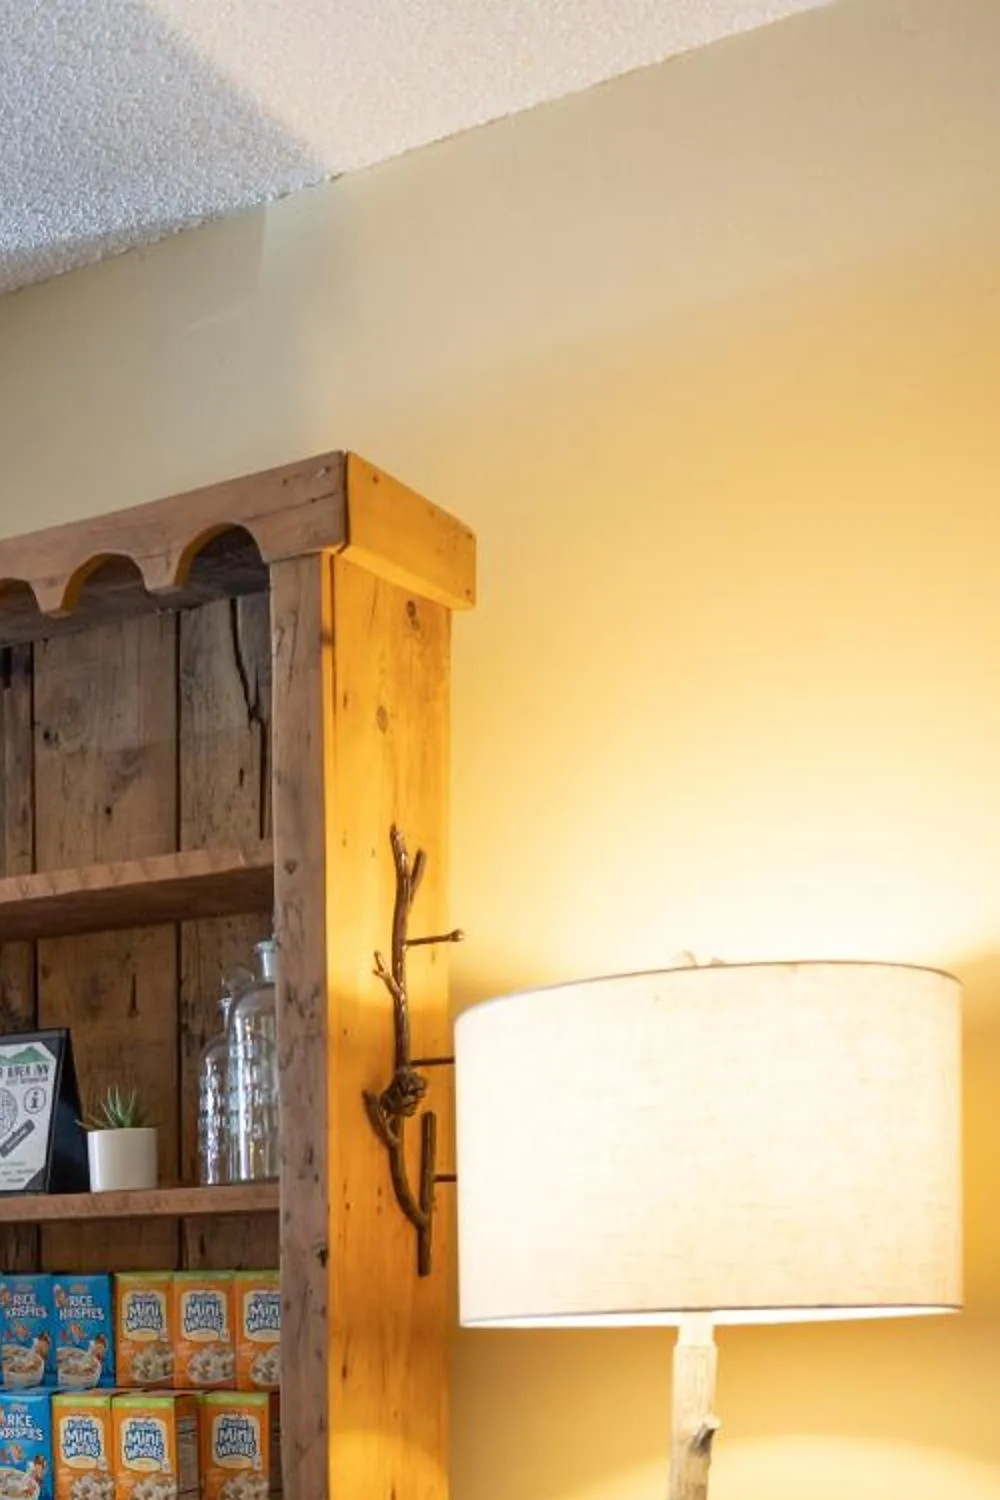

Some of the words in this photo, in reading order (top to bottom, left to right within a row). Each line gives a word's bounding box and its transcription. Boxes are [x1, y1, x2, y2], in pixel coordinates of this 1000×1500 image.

[13, 1293, 37, 1305] RICE
[69, 1295, 93, 1306] RICE
[249, 1303, 280, 1319] Min
[127, 1430, 161, 1446] Mini
[219, 1427, 255, 1443] Mini
